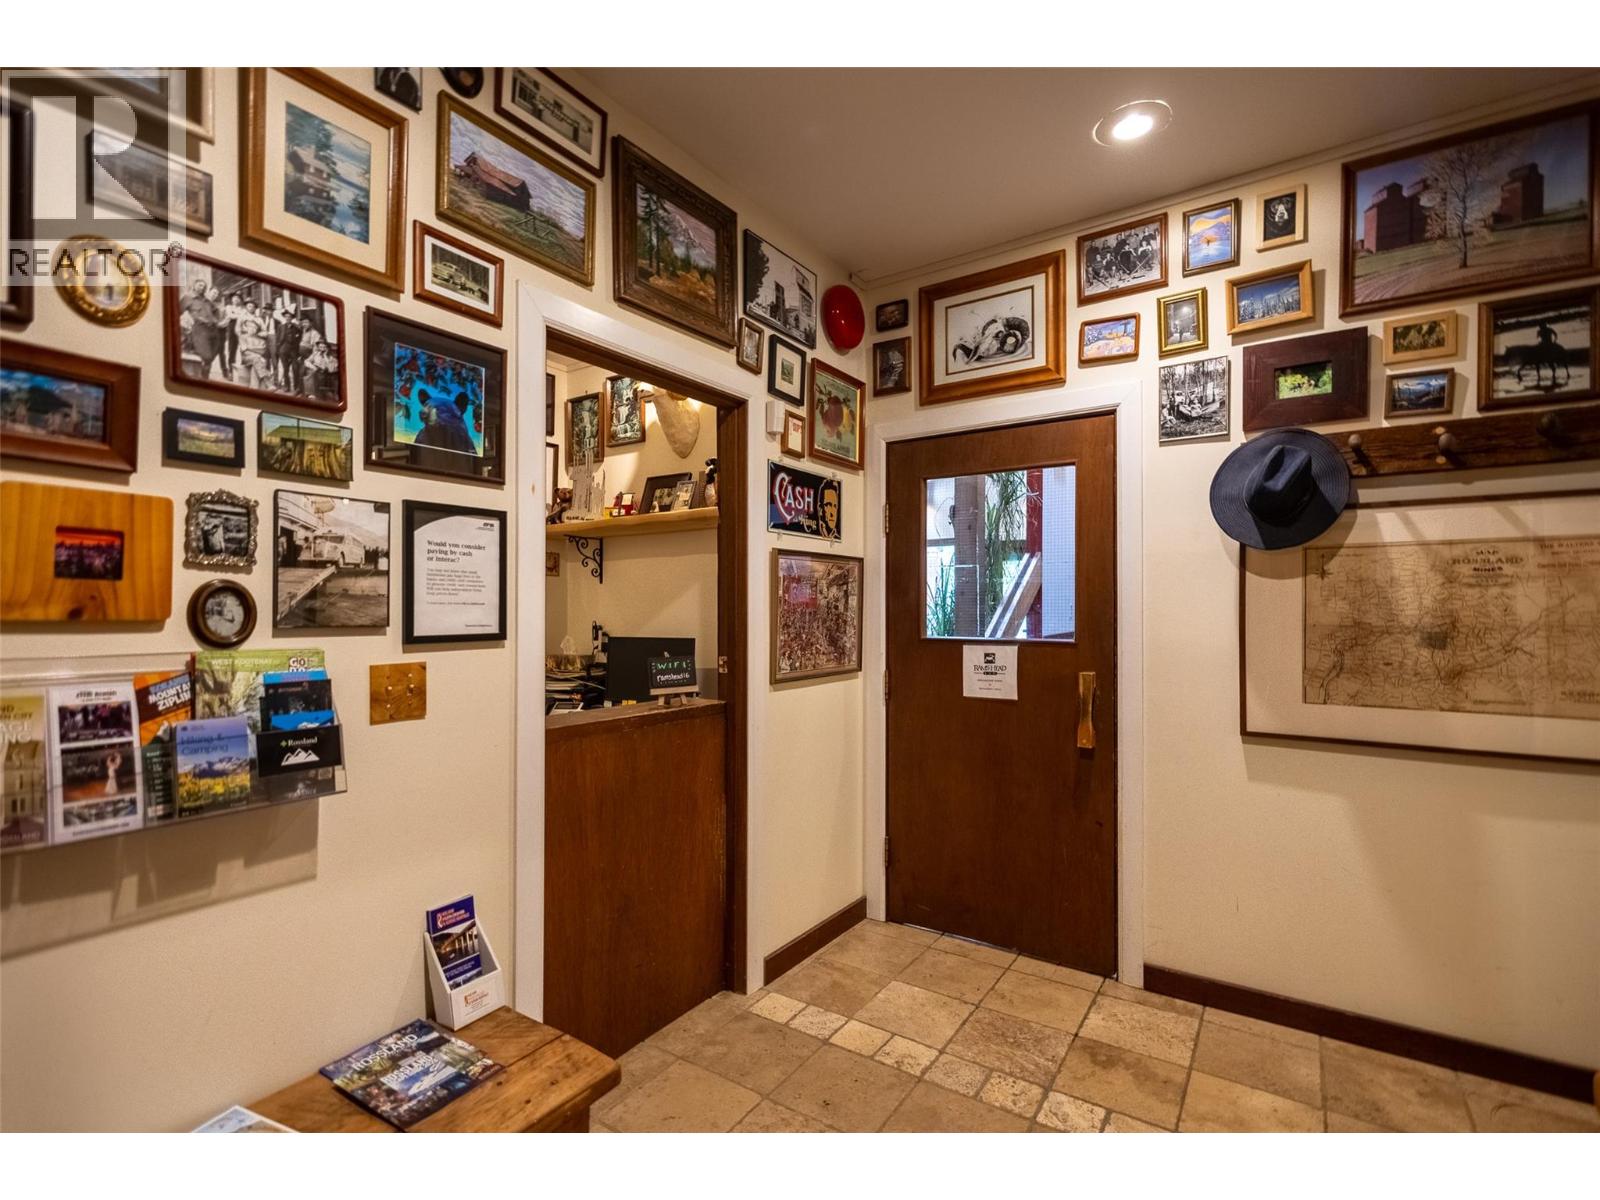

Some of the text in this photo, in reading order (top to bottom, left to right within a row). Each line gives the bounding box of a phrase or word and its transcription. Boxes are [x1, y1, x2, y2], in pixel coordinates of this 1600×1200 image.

[774, 471, 815, 521] CASH
[427, 539, 447, 548] Would
[461, 543, 486, 551] consider
[427, 548, 448, 557] paying
[288, 736, 318, 746] Rossland
[181, 744, 229, 755] Camping
[351, 1033, 418, 1072] ROSSLAND
